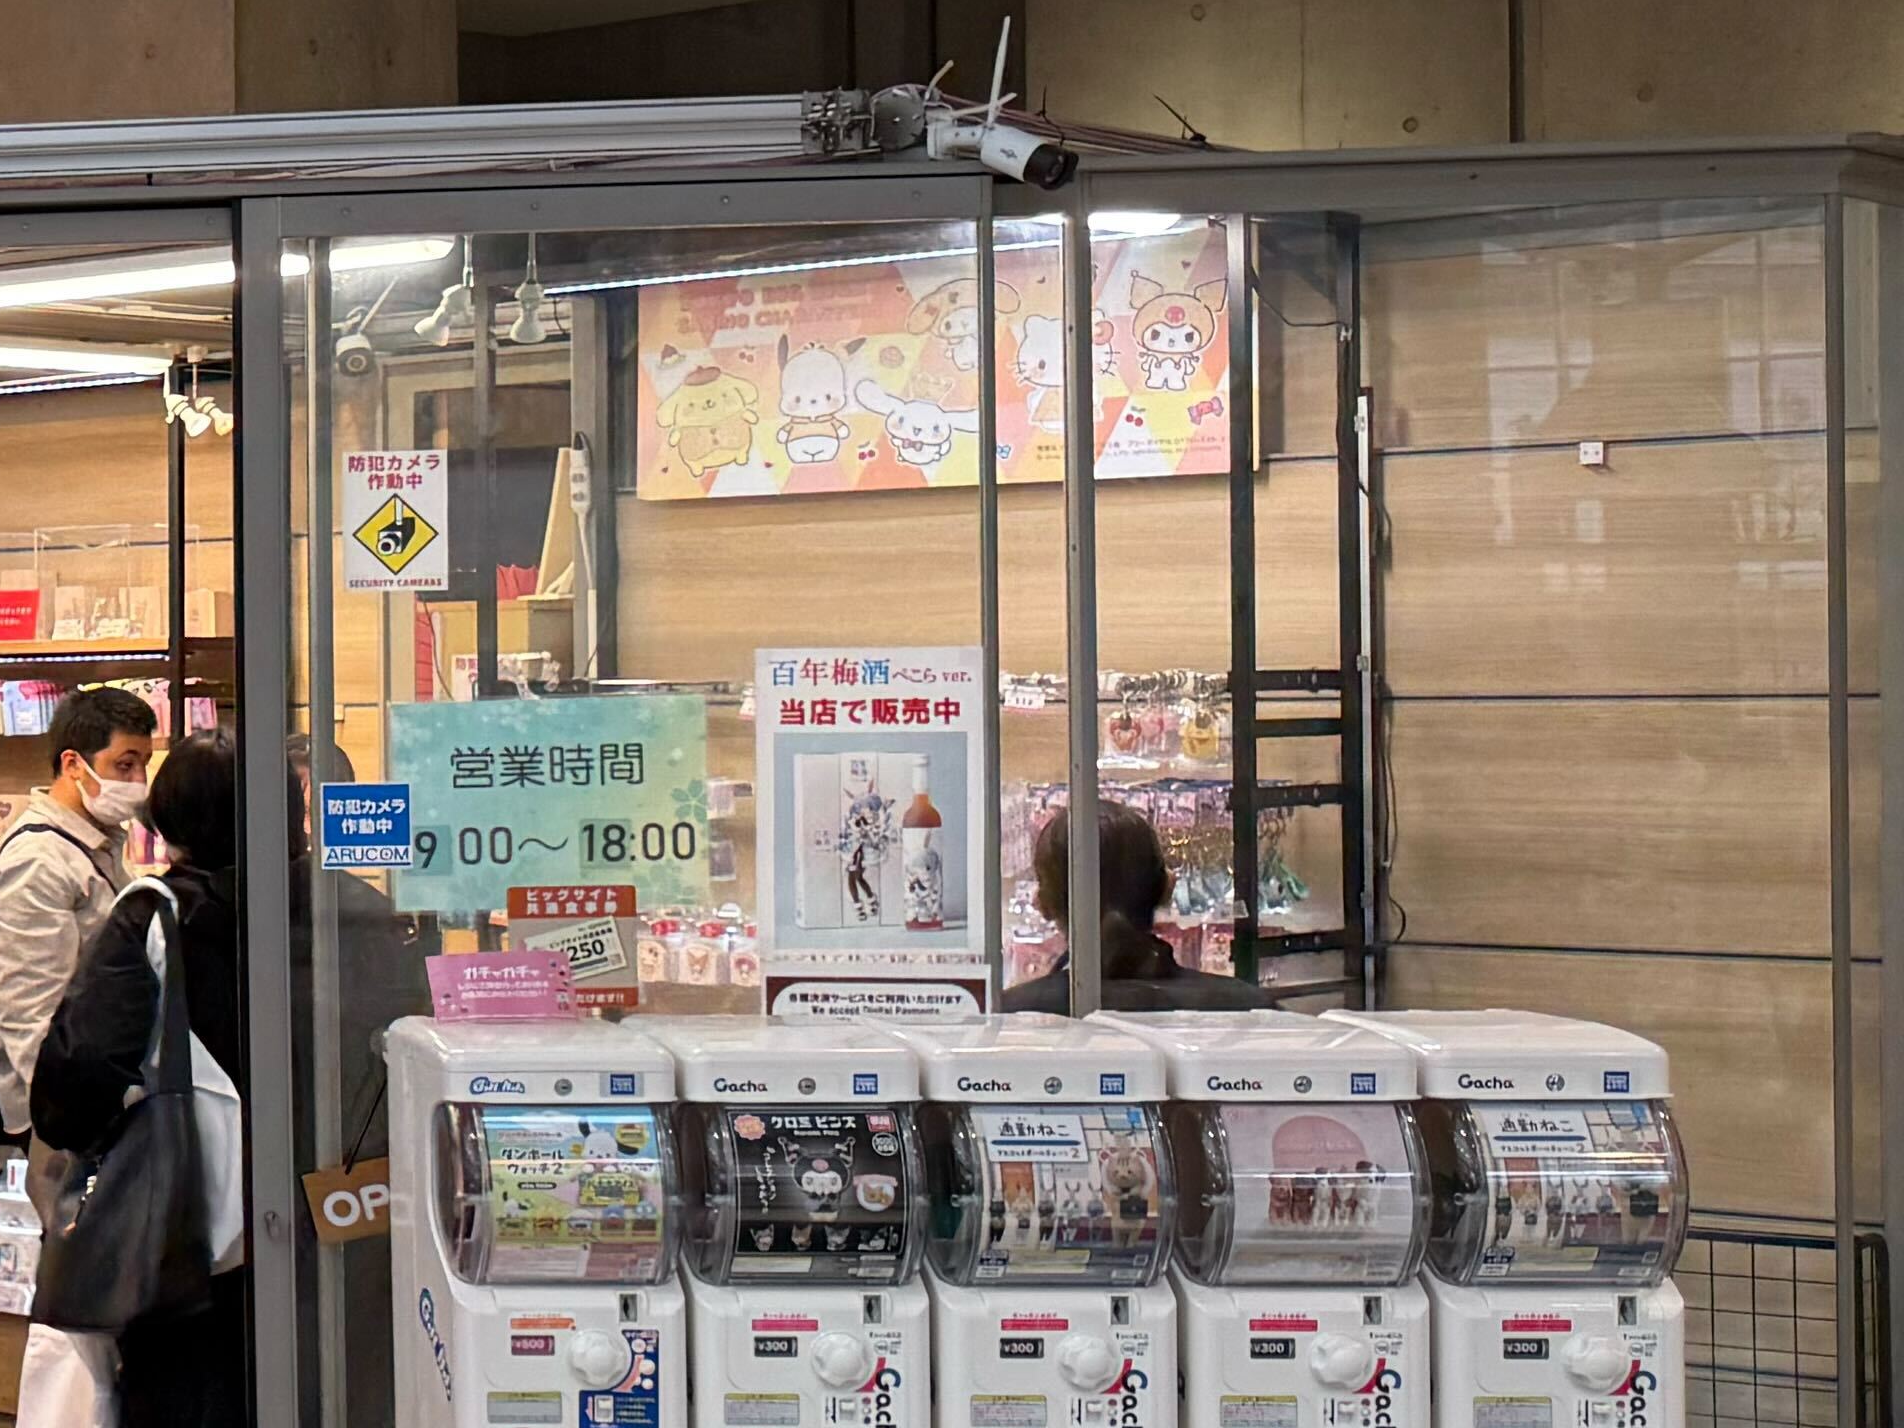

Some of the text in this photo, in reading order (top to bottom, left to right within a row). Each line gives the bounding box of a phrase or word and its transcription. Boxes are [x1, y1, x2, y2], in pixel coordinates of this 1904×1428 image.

[348, 454, 441, 473] 防犯カメラ
[368, 472, 423, 490] 作動中
[349, 579, 394, 588] SECURITY
[943, 672, 971, 683] ver.
[780, 697, 960, 725] 当店で販売中
[450, 742, 645, 790] 営業時間
[328, 798, 406, 815] 防犯カメラ
[342, 818, 393, 835] 作動中
[326, 847, 410, 862] ARUCOM
[527, 889, 617, 901] ビッグサイト
[714, 1076, 768, 1094] Gacha
[957, 1076, 1012, 1094] Gacha
[1207, 1075, 1263, 1092] Gacha
[1457, 1074, 1514, 1091] Gacha
[1000, 1121, 1070, 1137] 通勤ねこ
[1500, 1118, 1574, 1133] 通勤ねこ
